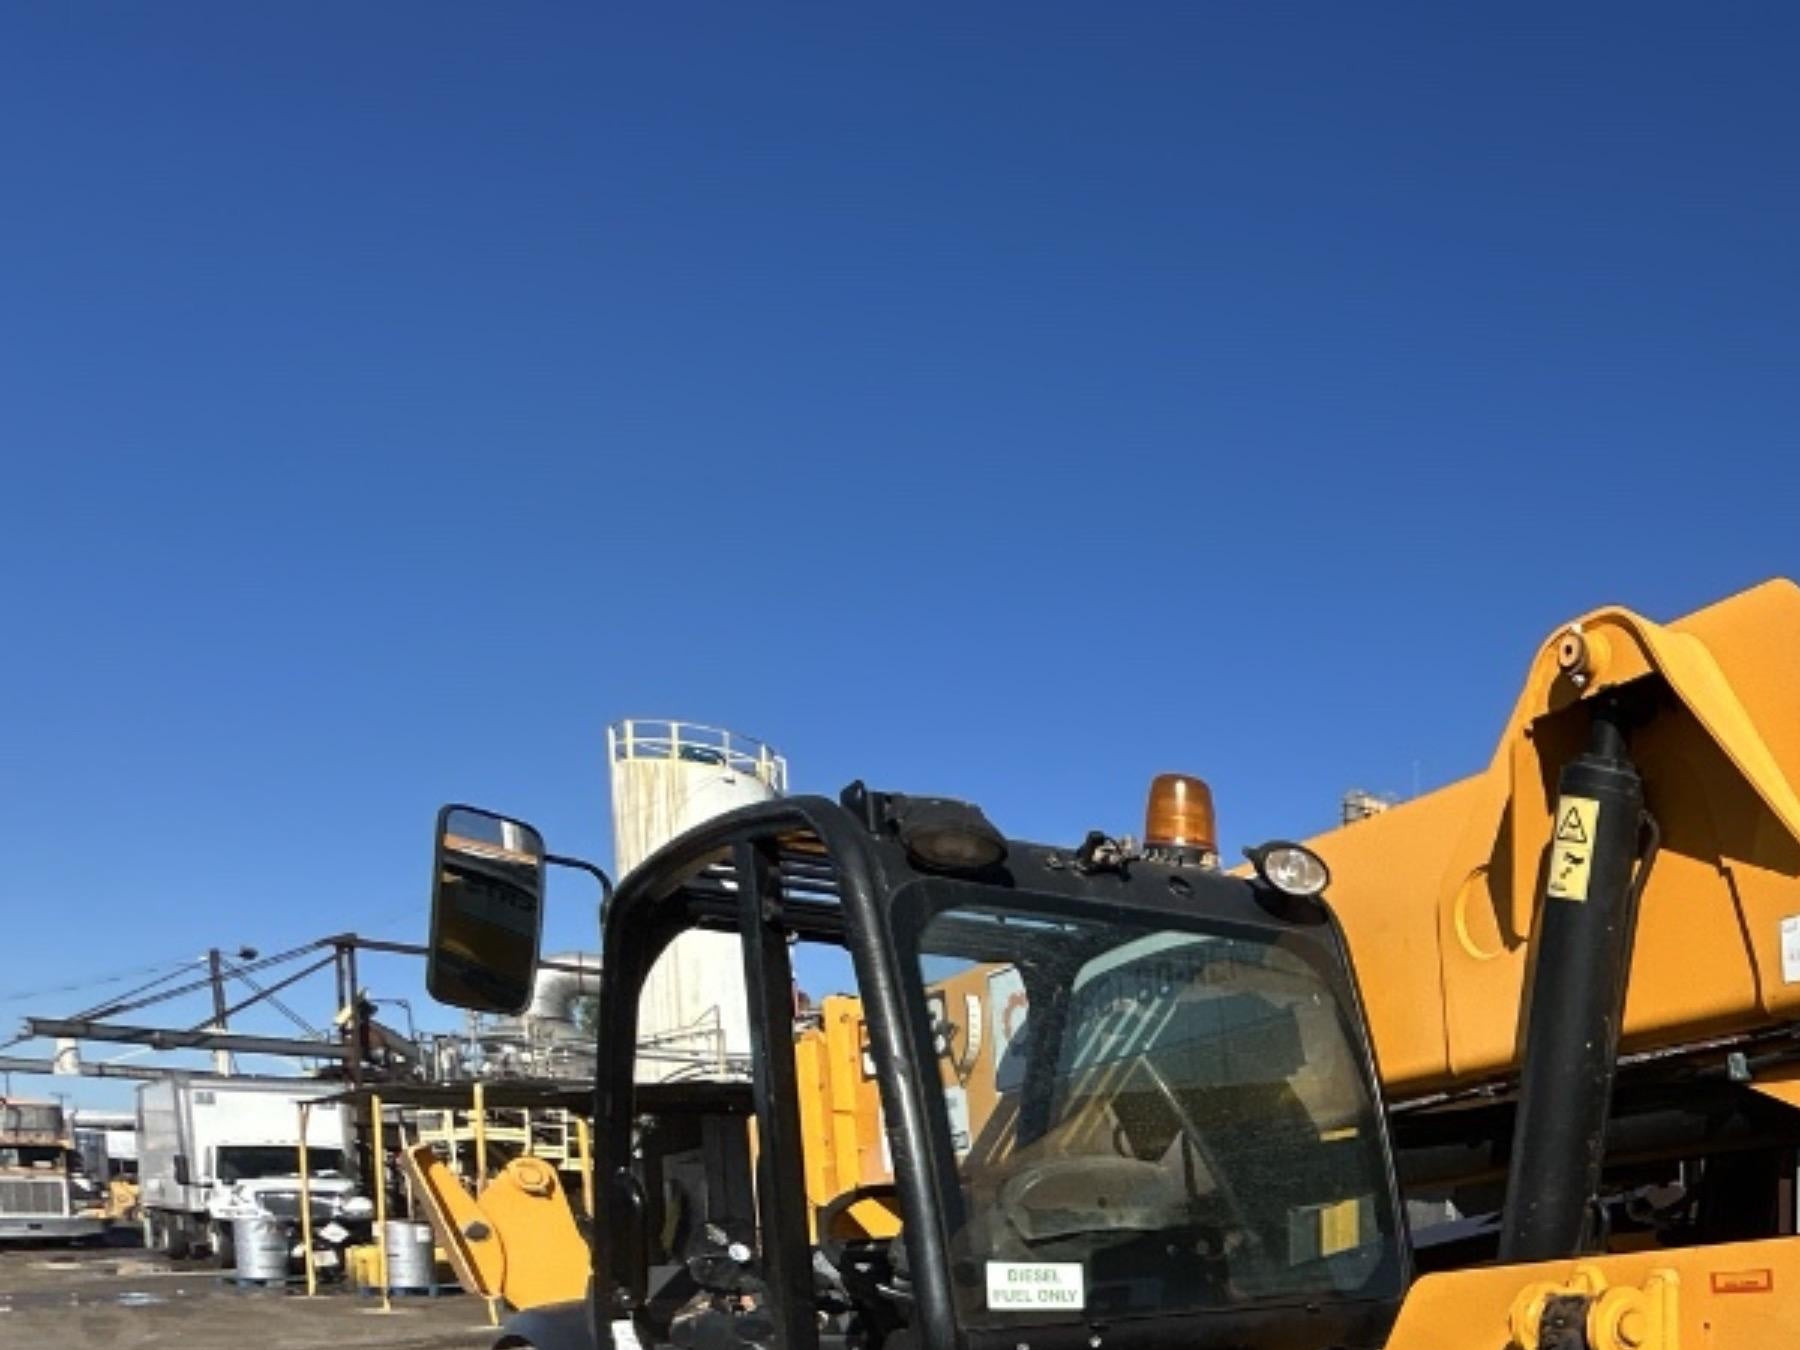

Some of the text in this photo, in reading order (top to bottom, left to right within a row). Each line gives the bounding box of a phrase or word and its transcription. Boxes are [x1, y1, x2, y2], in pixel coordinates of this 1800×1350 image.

[1007, 1267, 1062, 1284] DIESEL
[992, 1288, 1078, 1303] FUEL ONLY
